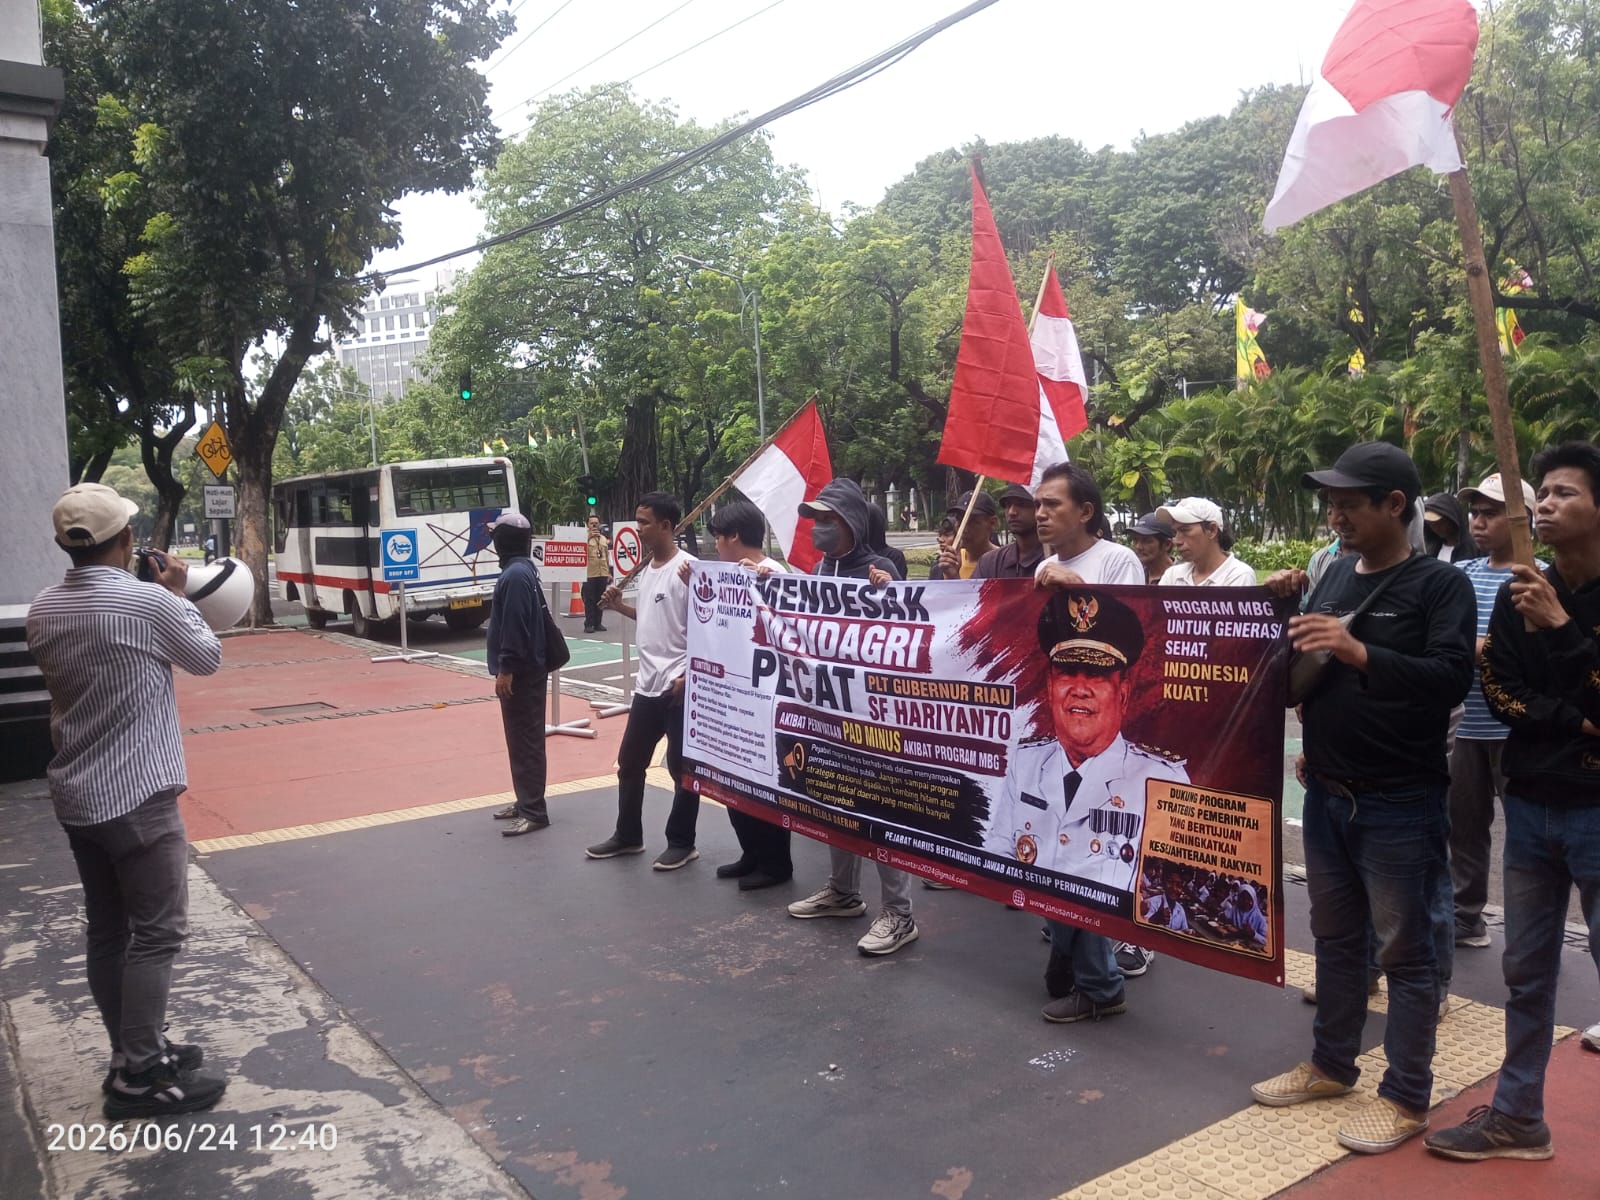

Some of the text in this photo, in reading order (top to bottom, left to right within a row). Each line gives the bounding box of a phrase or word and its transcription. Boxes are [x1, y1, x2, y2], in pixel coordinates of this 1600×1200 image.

[545, 556, 585, 565] HARAP DIBUKA
[573, 545, 586, 553] MOBIL
[717, 604, 752, 619] NUSANTARA
[755, 575, 930, 622] MENDESAK
[1162, 600, 1275, 616] PROGRAM MBG
[759, 610, 924, 669] MENDAGRI
[1167, 619, 1283, 639] UNTUK GENERASI
[1165, 640, 1208, 660] SEHAT,
[752, 648, 855, 713] PECAT
[1164, 661, 1249, 683] INDONESIA
[868, 674, 1011, 706] PLT GUBERNUR RIAU
[1163, 683, 1209, 702] KUAT!
[868, 695, 1011, 741] SF HARIYANTO
[779, 711, 806, 729] AKIBAT
[842, 721, 863, 744] PAD
[864, 725, 901, 753] MINUS
[904, 740, 932, 759] AKIBAT
[935, 745, 976, 766] PROGRAM
[979, 751, 1000, 770] MBG
[806, 766, 835, 779] strategis
[920, 792, 939, 804] hitam
[941, 798, 955, 809] atas
[808, 755, 841, 768] pernyataan
[879, 772, 902, 786] Jangan
[905, 778, 928, 792] sampai
[931, 783, 959, 798] program
[895, 763, 913, 775] dalam
[914, 768, 961, 785] menyampaikan
[806, 778, 950, 820] persoalan fiskal daerah yang memiliki banyak
[823, 793, 855, 808] penyebab.
[1170, 788, 1247, 813] DUKUNG PROGRAM
[1156, 799, 1259, 831] STRATEGIS PEMERINTAH
[1169, 815, 1242, 842] YANG BERTUJUAN
[1170, 831, 1237, 856] MENINGKATKAN
[884, 831, 1120, 907] PEJABAT HARUS BERTANGGUNG JAWAB ATAS SETIAP PERNYATAANNYA!
[1149, 840, 1262, 876] KESEJAHTERAAN RAKYAT!
[1029, 898, 1101, 927] www.janusantara.or.id
